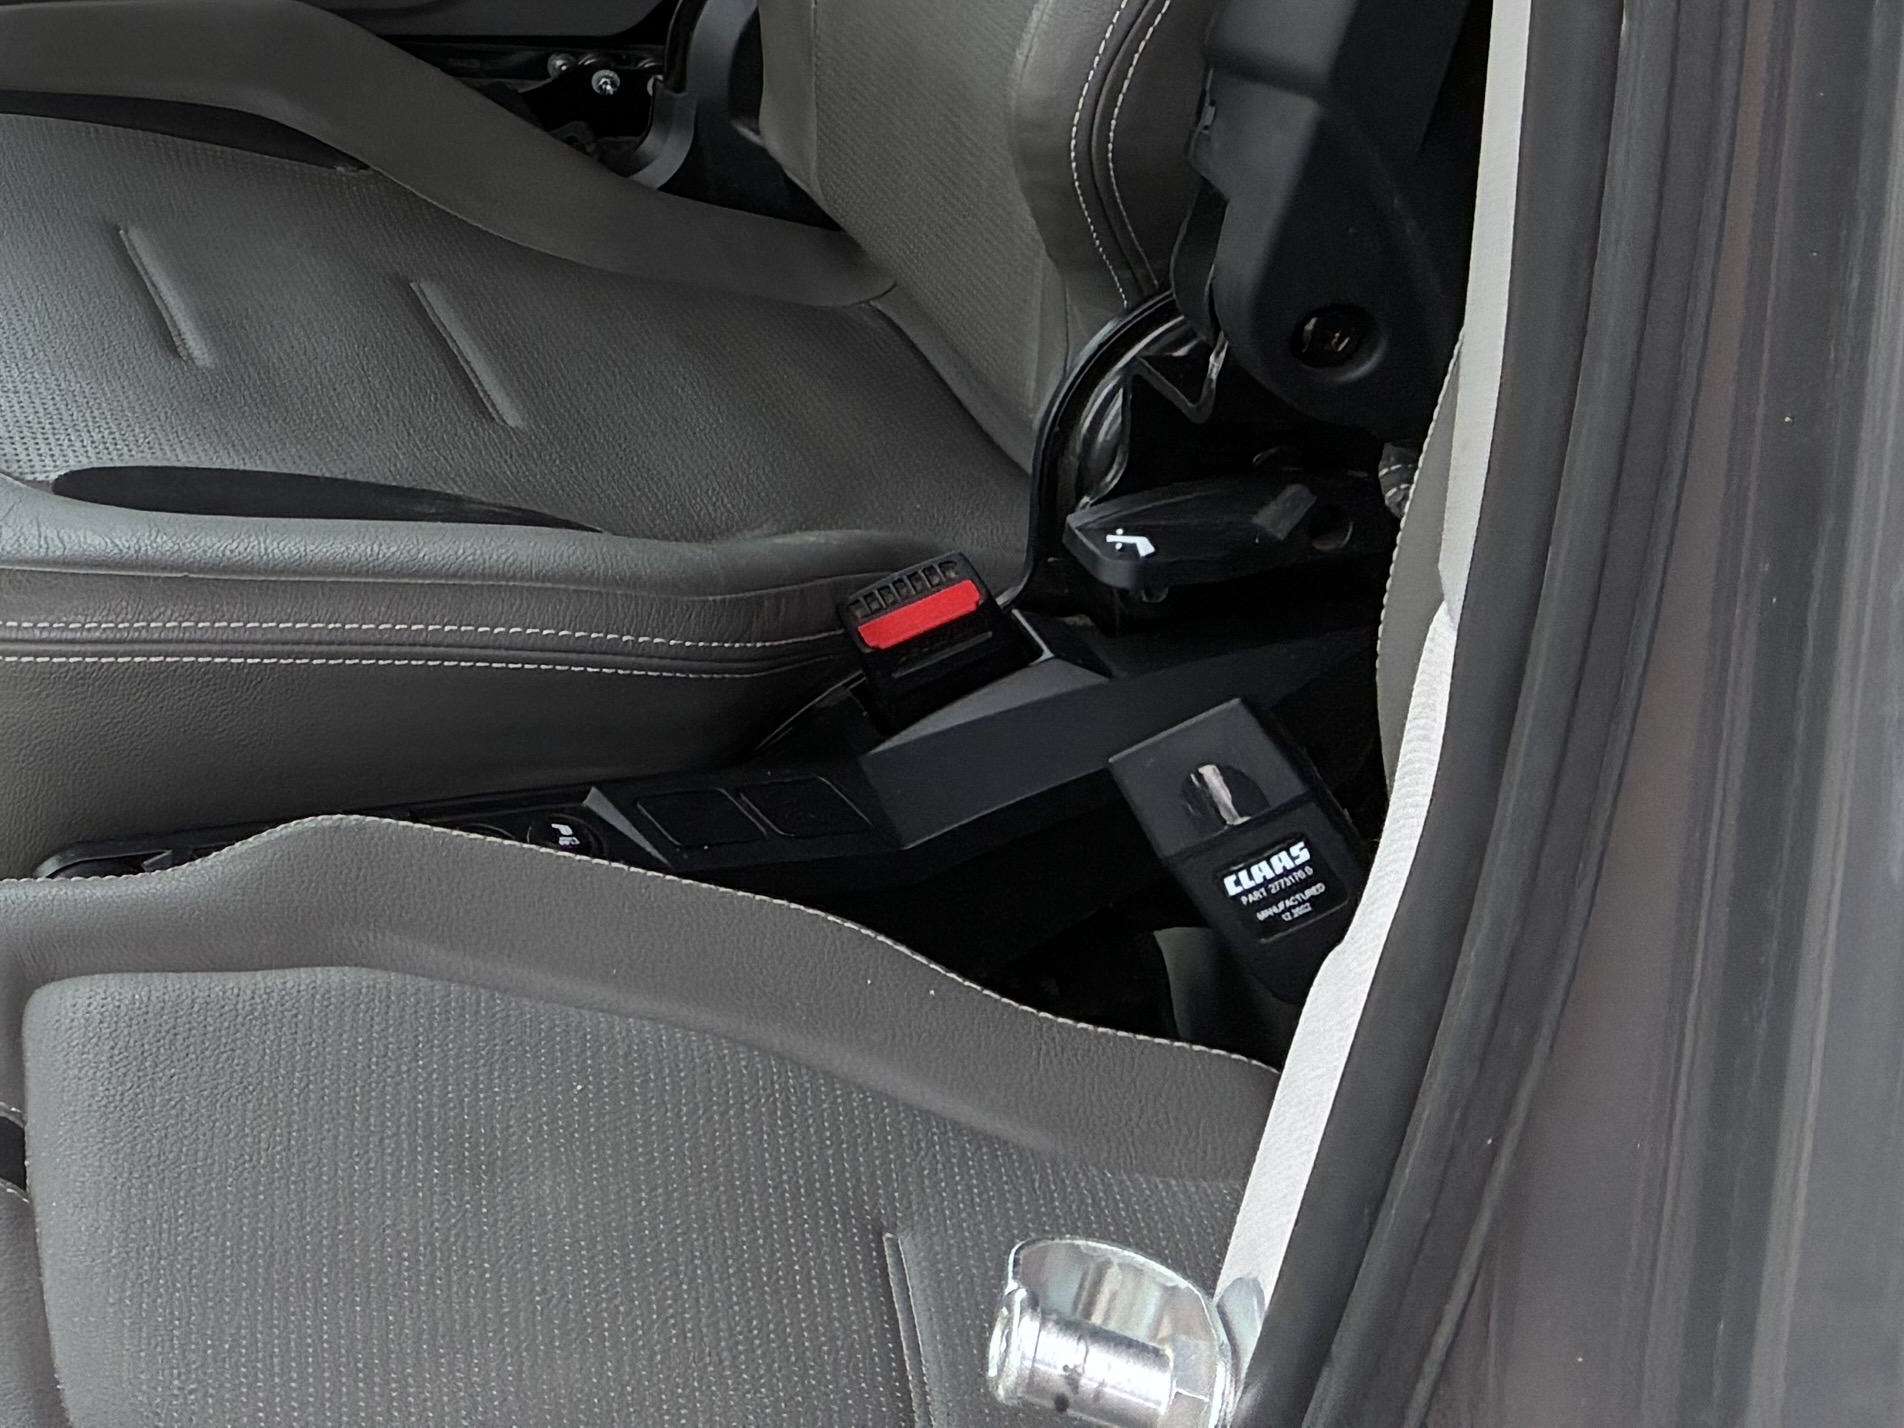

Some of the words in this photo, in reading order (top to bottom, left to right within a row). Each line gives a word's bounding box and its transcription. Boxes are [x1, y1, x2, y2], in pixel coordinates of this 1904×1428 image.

[1223, 841, 1311, 896] CLAAS
[1240, 888, 1267, 906] PART
[1256, 882, 1326, 921] MANUFACTURED
